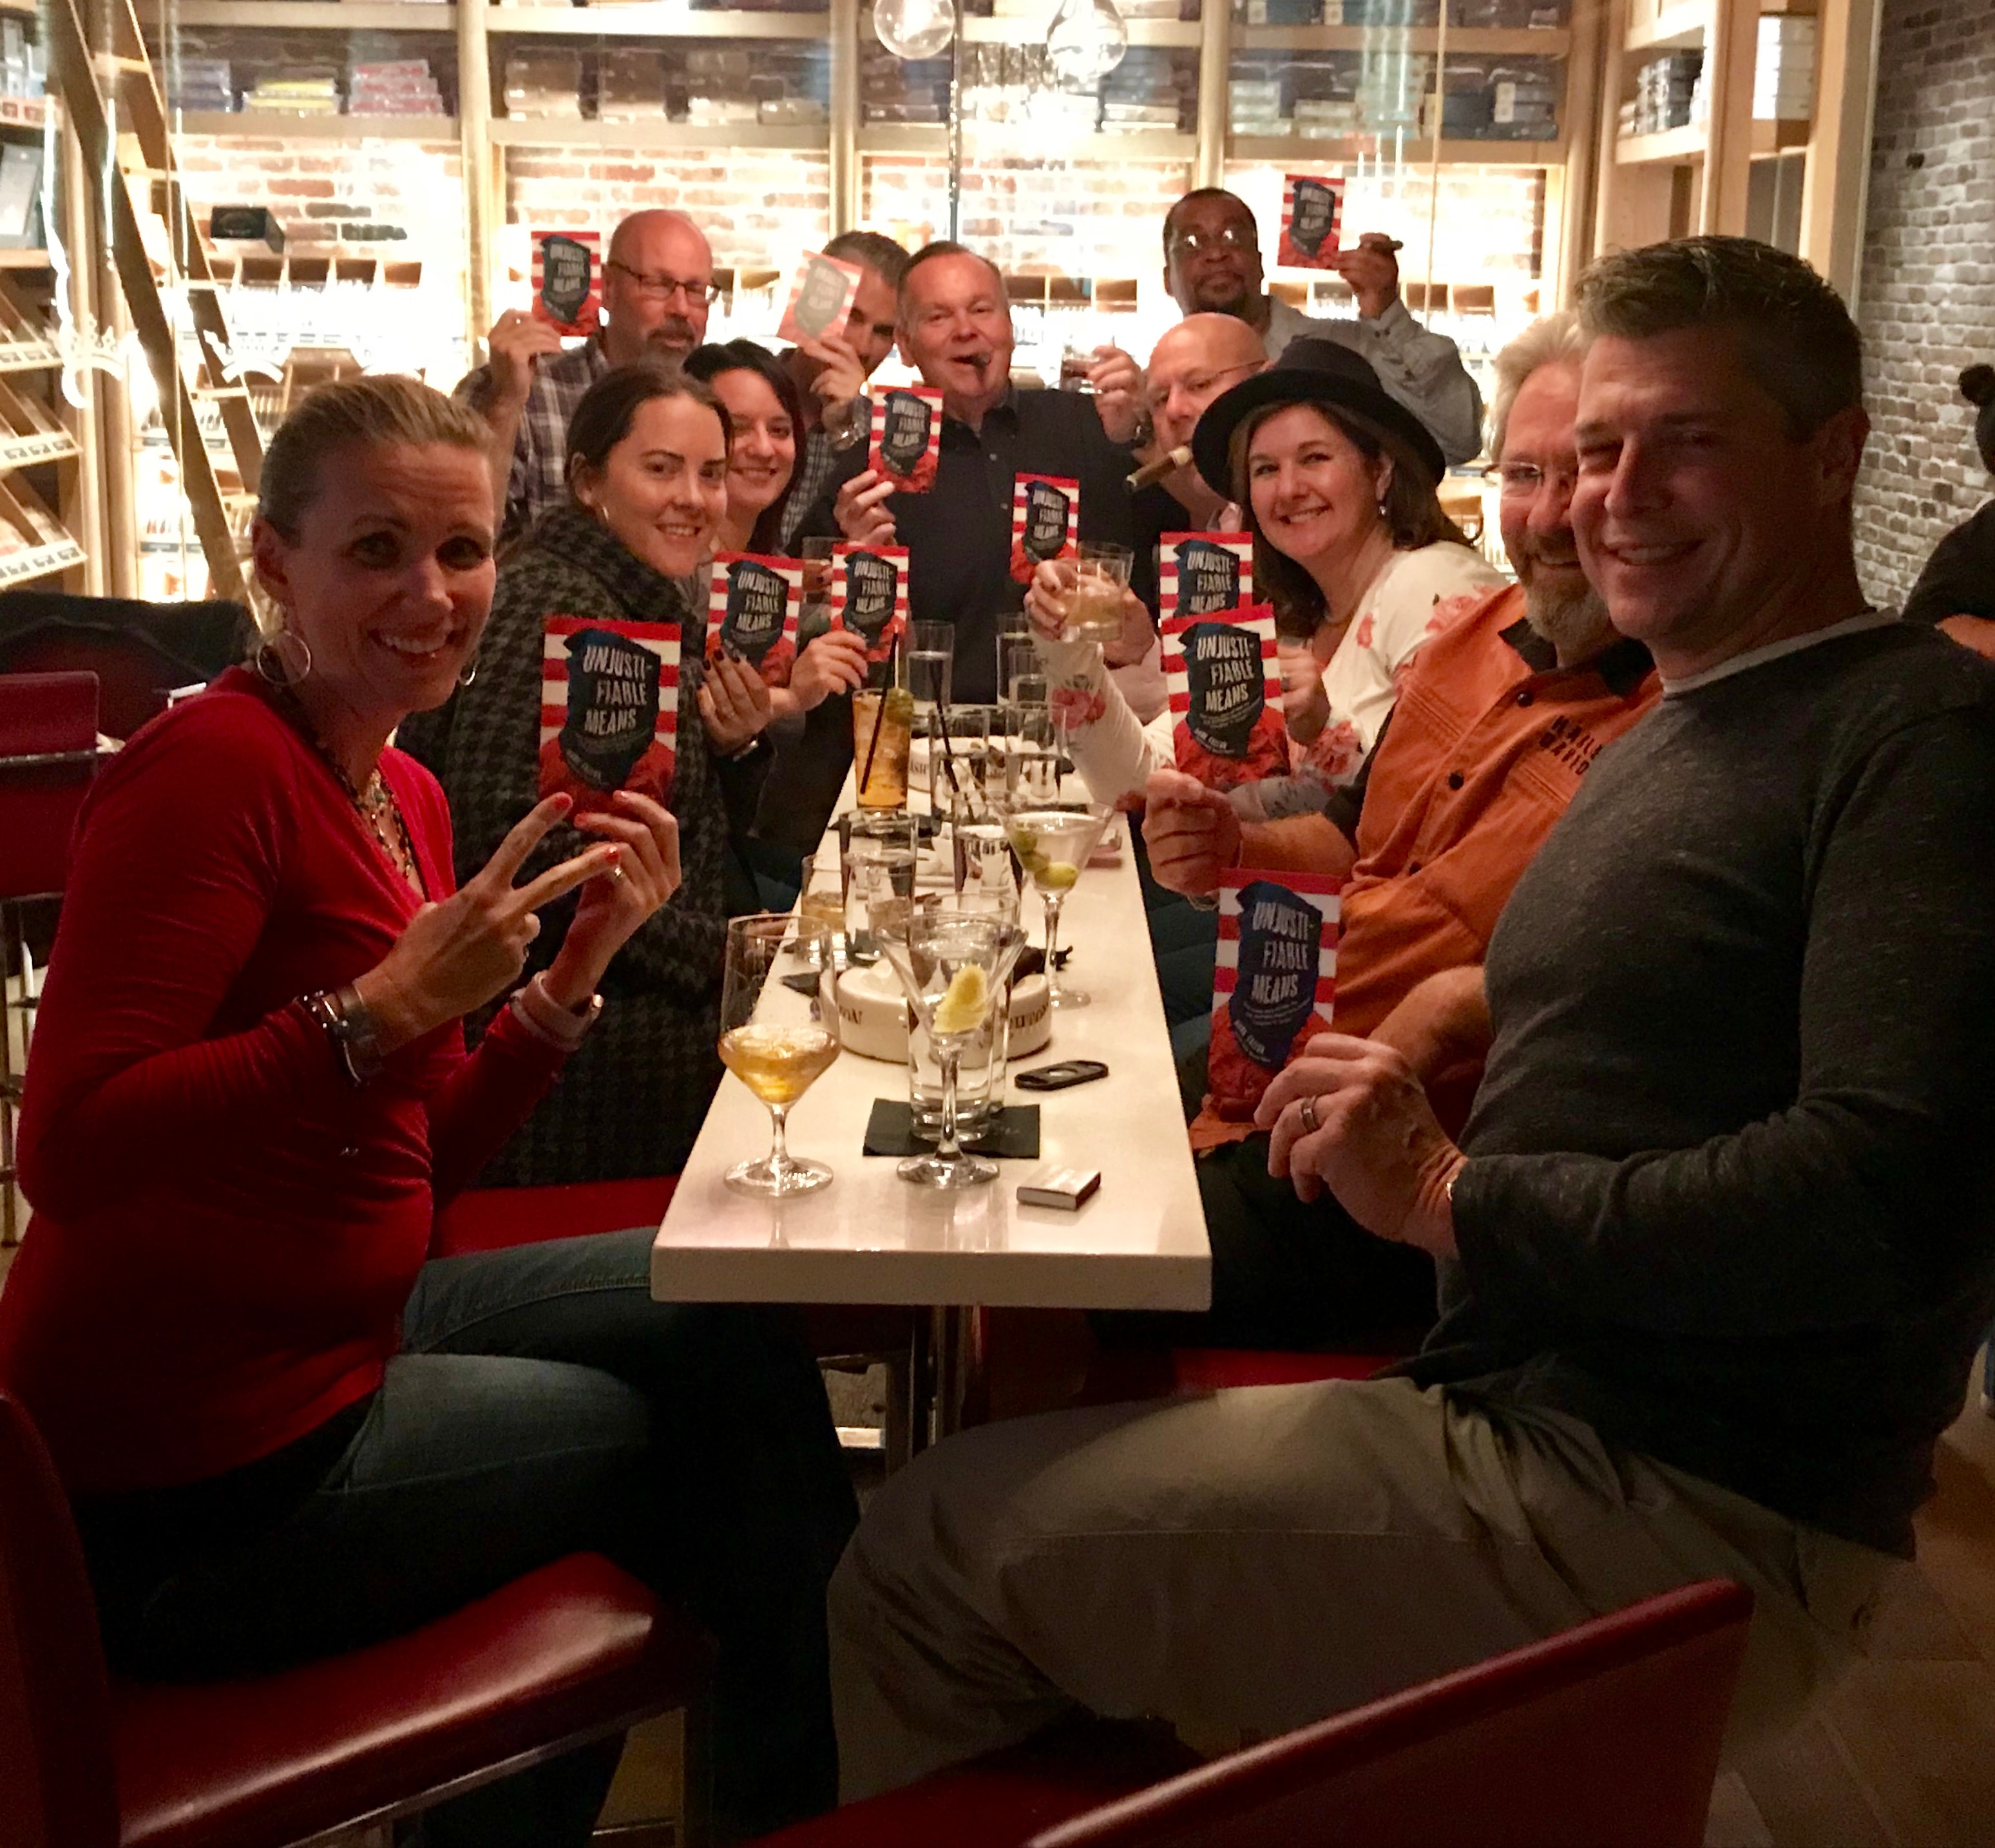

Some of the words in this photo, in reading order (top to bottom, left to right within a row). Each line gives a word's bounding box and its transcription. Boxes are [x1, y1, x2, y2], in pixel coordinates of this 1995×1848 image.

[1197, 573, 1232, 592] FIABLE
[745, 594, 779, 614] FIABLE
[1189, 593, 1226, 614] MEANS
[1197, 634, 1255, 661] UNJUSTI-
[583, 645, 653, 681] UNJUSTI-
[1210, 659, 1255, 686] FIABLE
[596, 680, 647, 706] FIABLE
[1205, 683, 1249, 712] MEANS
[584, 709, 636, 736] MEANS
[1263, 940, 1309, 970] FIABLE
[1251, 973, 1299, 1004] MEANS
